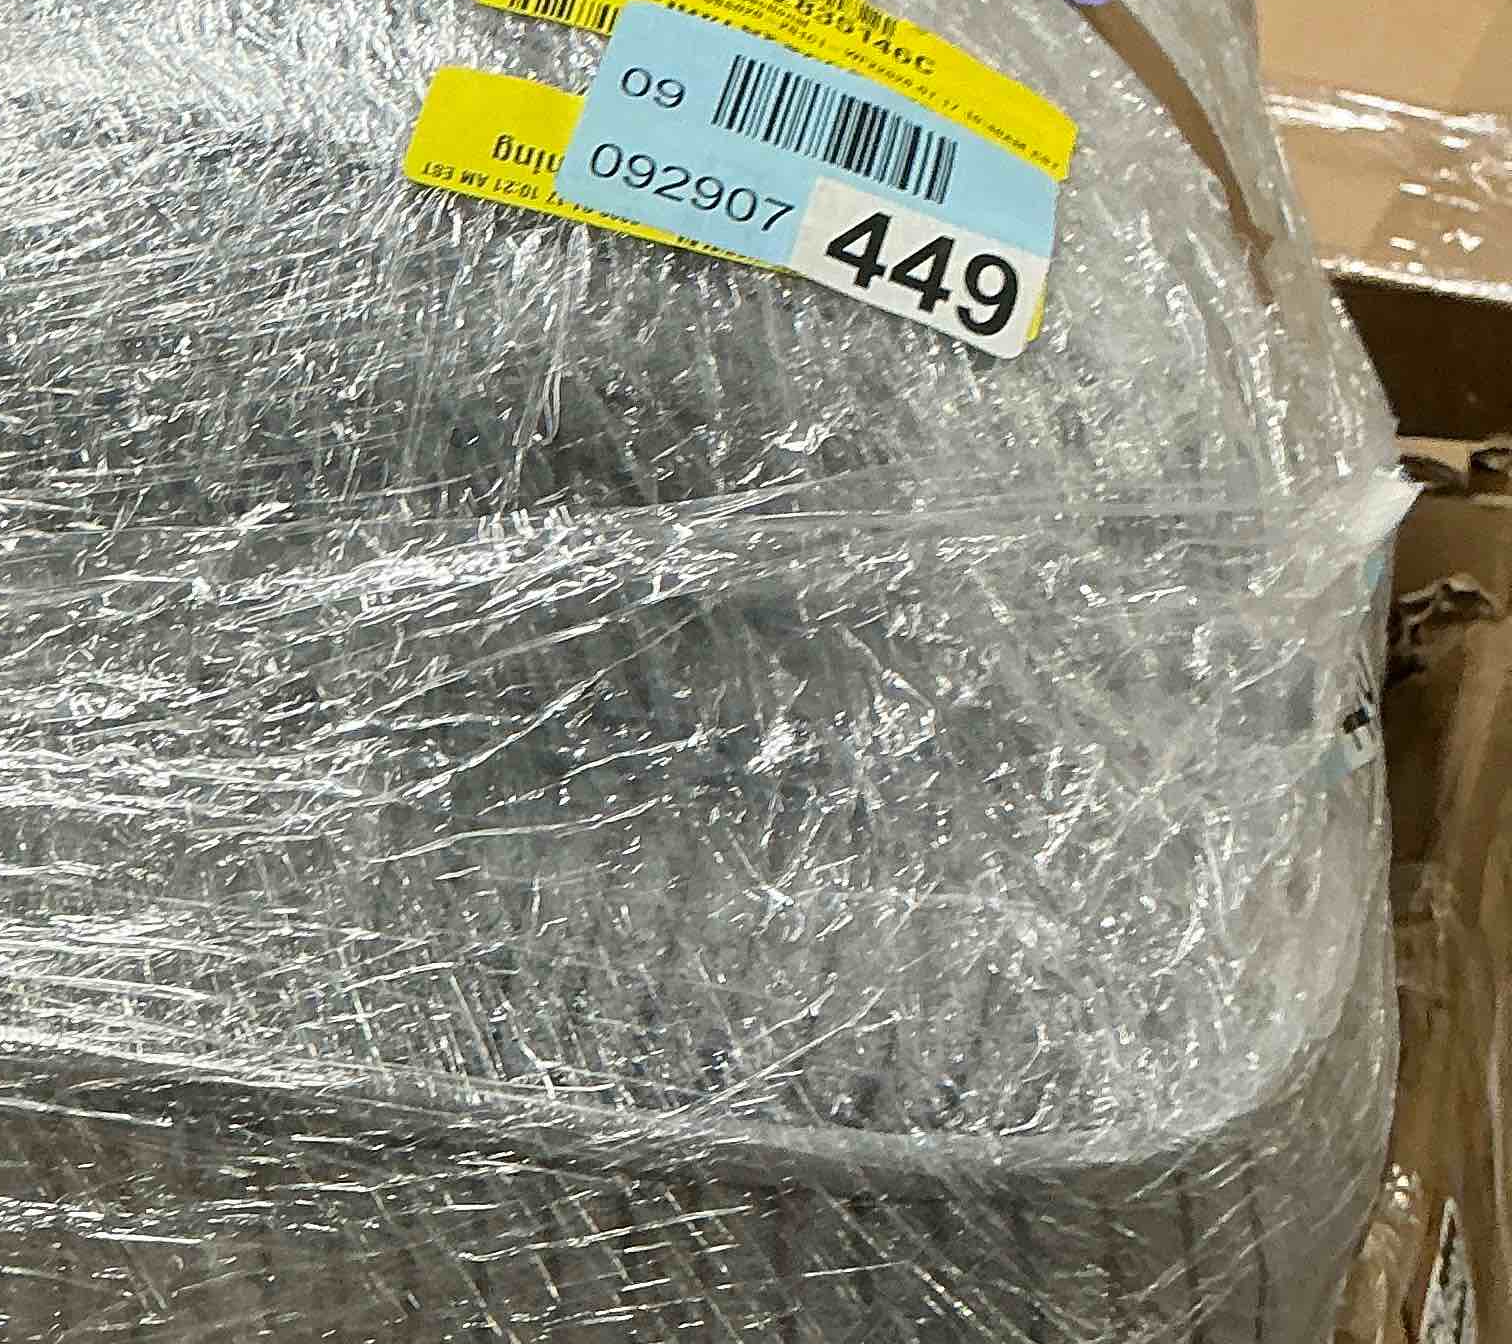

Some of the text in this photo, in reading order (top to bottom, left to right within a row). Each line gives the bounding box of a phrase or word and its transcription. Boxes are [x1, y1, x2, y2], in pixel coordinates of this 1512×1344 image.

[620, 66, 687, 111] 09
[588, 142, 795, 233] 092907
[826, 211, 1019, 336] 449
